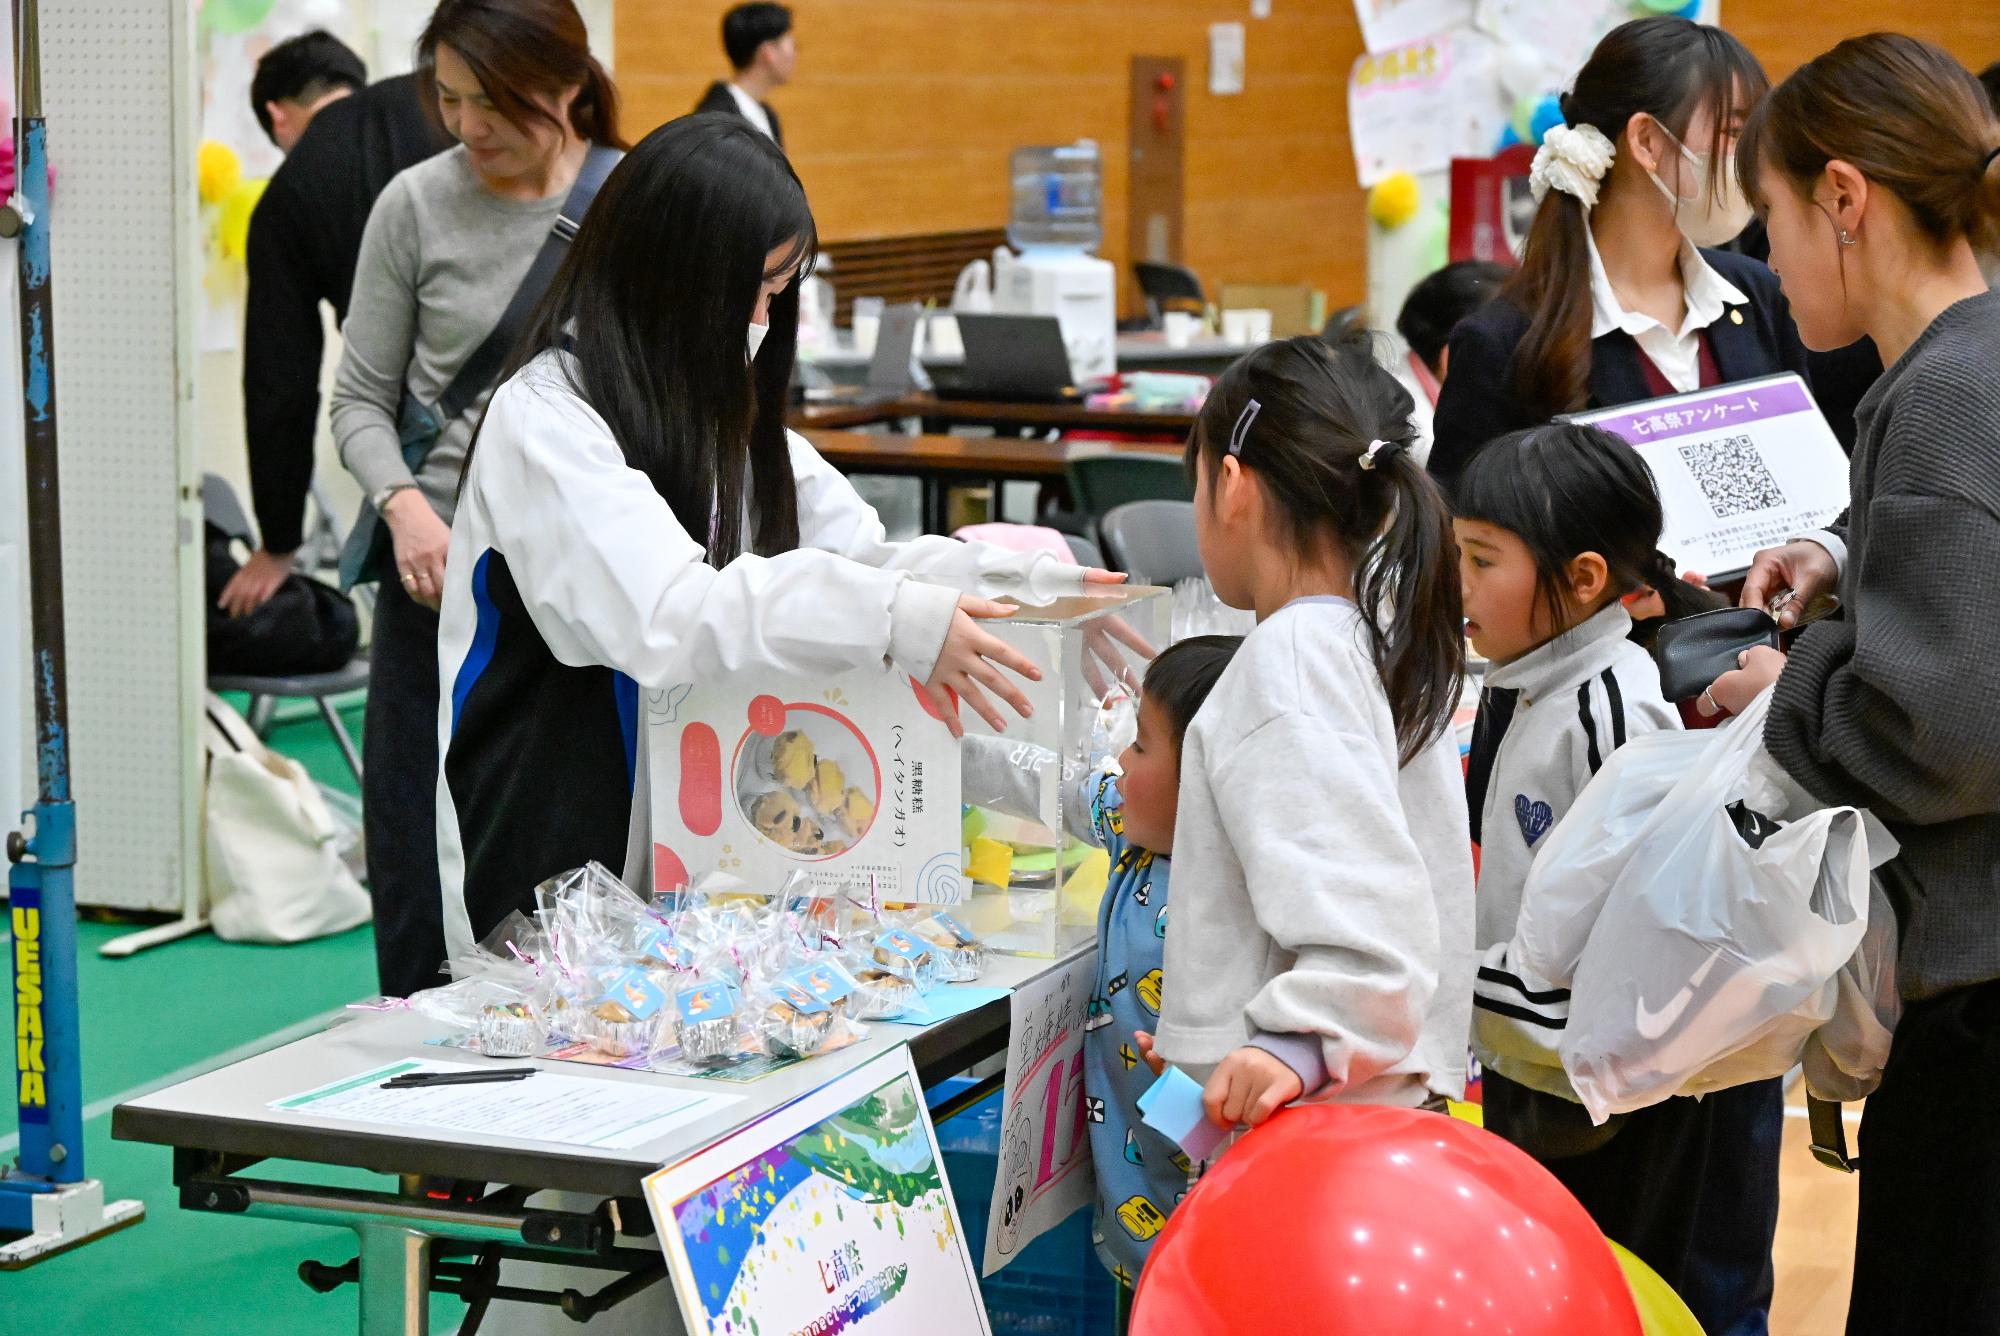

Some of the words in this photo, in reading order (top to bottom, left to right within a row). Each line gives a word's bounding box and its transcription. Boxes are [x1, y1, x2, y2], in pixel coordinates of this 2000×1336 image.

[1631, 396, 1760, 436] 七高祭アンケート
[12, 906, 46, 1107] UESAKA
[817, 1239, 864, 1295] 七高祭
